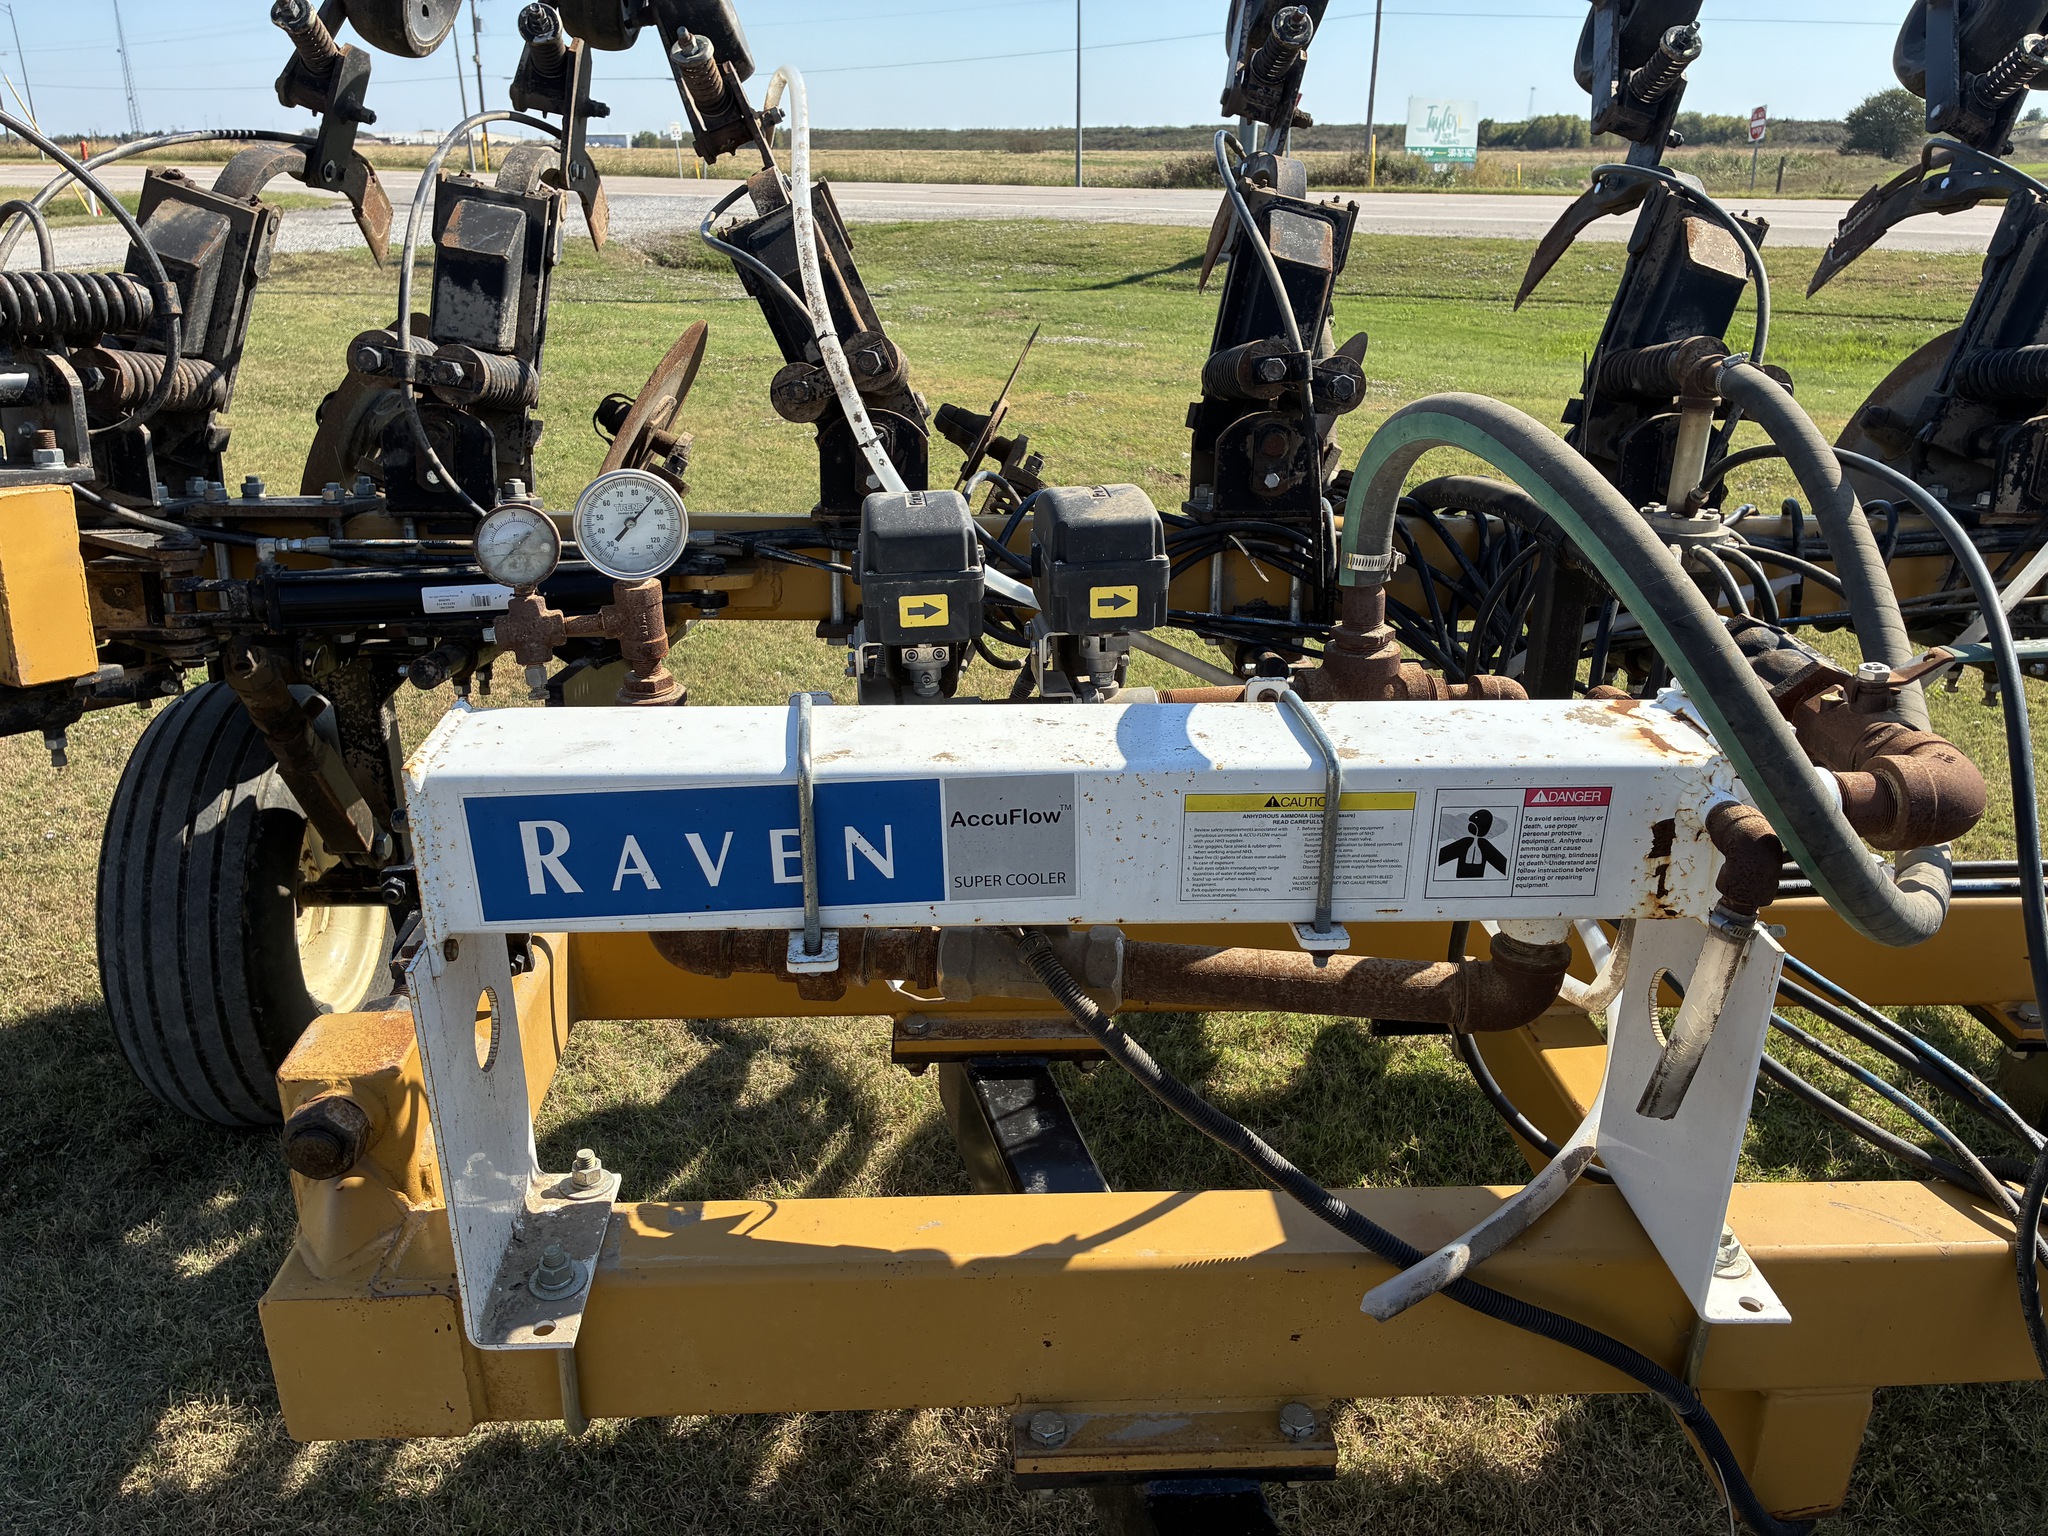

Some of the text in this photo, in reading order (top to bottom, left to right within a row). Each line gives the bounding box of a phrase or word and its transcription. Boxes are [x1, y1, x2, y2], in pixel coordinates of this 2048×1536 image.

[613, 503, 644, 512] TREND
[606, 540, 614, 548] 30
[1280, 796, 1326, 808] CAUTIO
[1548, 790, 1602, 802] DANGER
[519, 820, 895, 895] RAVEN
[954, 872, 1067, 888] SUPER COOLER
